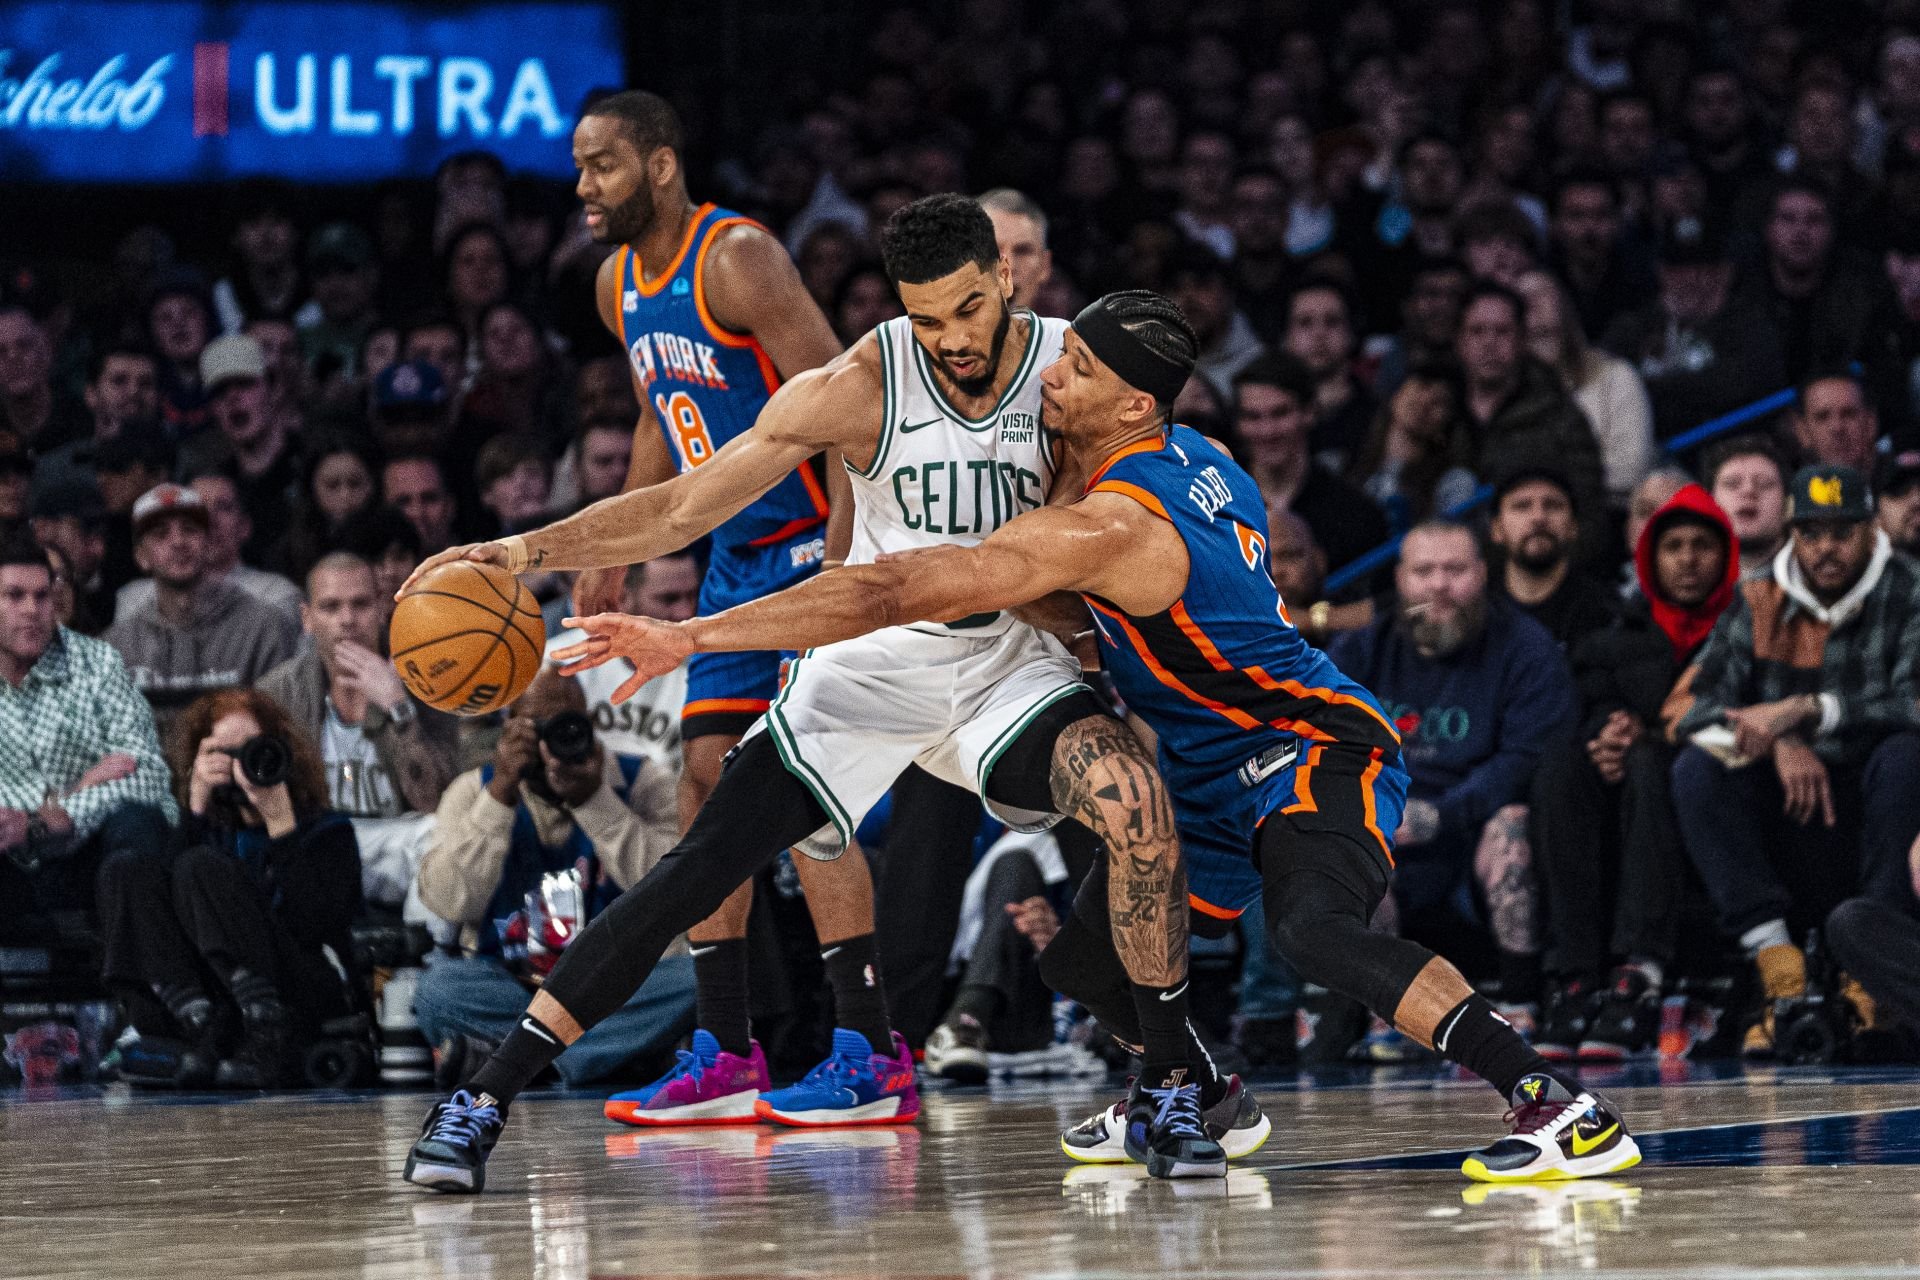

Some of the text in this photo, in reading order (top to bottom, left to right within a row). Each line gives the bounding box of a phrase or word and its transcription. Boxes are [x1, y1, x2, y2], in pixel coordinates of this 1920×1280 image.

[0, 48, 566, 137] chelob ULTRA
[653, 332, 729, 390] YORK
[1002, 413, 1034, 430] VISTA
[1001, 431, 1034, 443] PRINT
[790, 539, 825, 568] NYC
